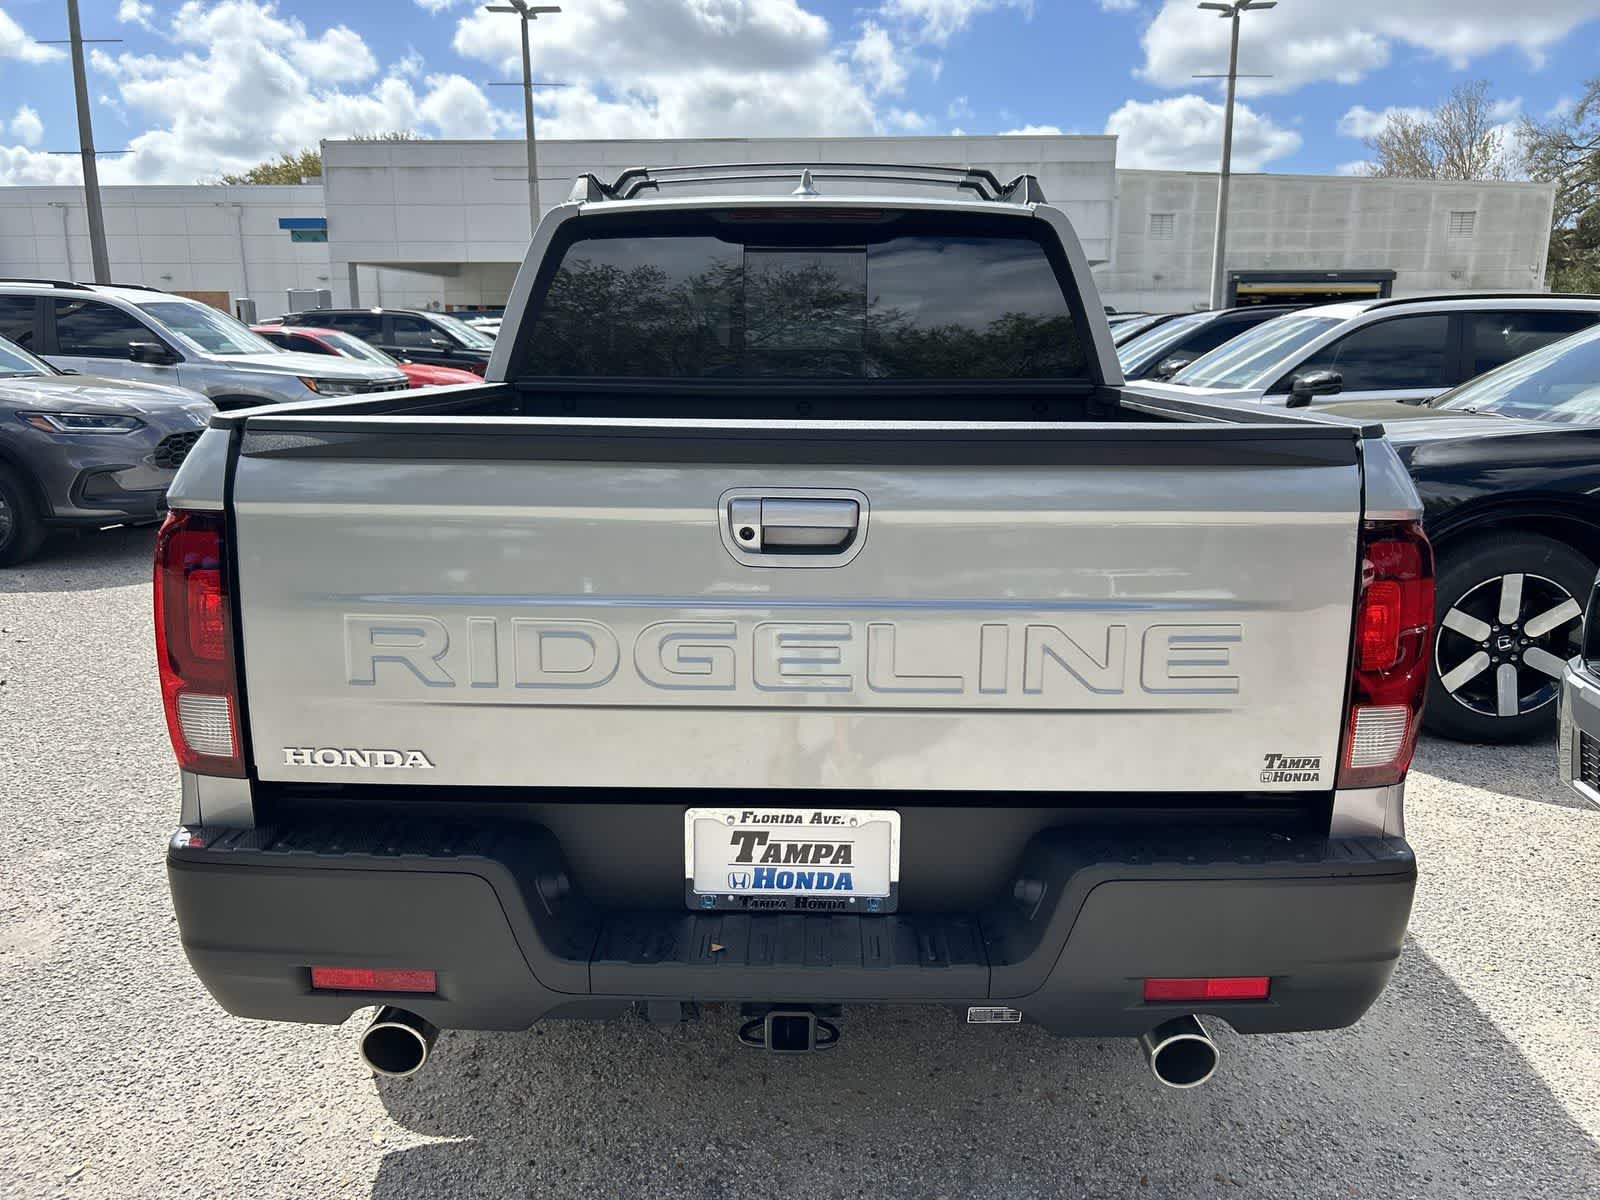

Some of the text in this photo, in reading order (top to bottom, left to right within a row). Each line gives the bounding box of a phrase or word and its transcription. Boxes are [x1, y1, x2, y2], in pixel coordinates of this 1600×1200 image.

[343, 613, 1243, 696] RIDGELINE
[281, 747, 435, 769] HONDA
[1263, 753, 1321, 769] TAMPA
[1272, 771, 1320, 783] HONDA
[740, 811, 845, 825] FLORIDA AVE.
[729, 830, 853, 865] TAMPA
[751, 867, 854, 891] HONDA
[738, 895, 847, 911] TAMPA HONDA
